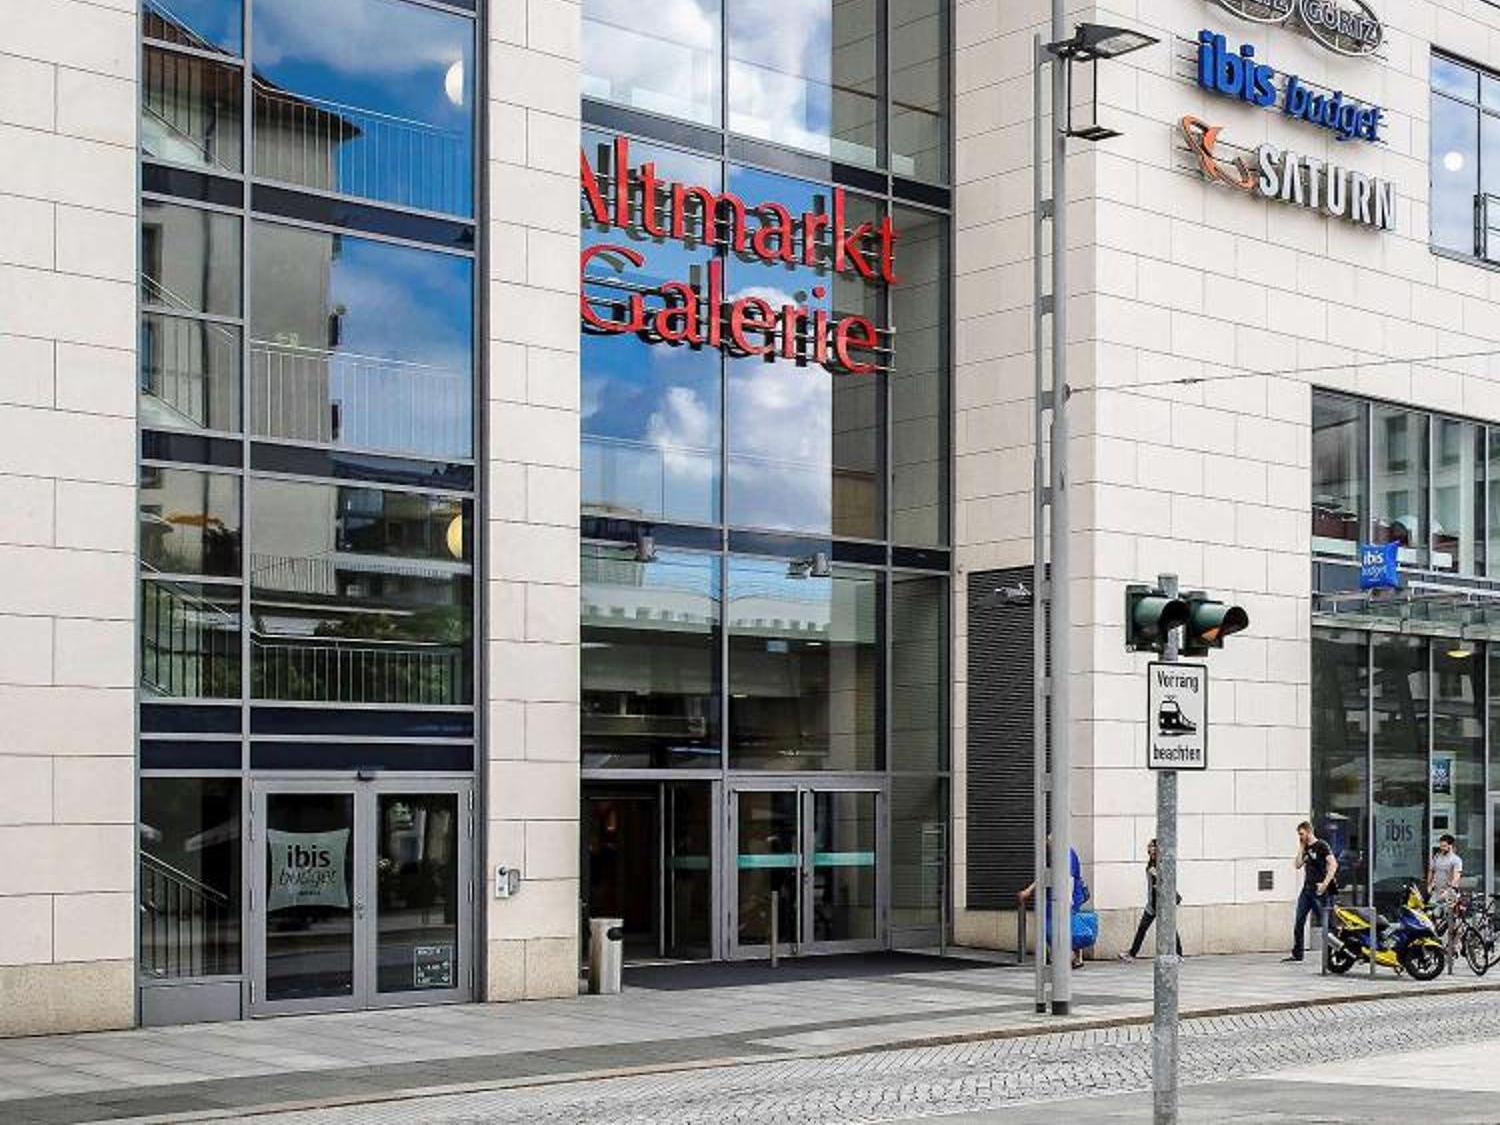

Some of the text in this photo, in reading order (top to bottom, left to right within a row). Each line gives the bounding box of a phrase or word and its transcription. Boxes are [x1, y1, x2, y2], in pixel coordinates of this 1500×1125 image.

[1197, 29, 1385, 143] ibis budget
[1257, 143, 1397, 231] SATURN
[580, 243, 882, 374] Galerie
[1363, 551, 1384, 566] ibis
[1157, 671, 1199, 694] Vorrang
[1153, 743, 1201, 761] beachten
[1385, 819, 1413, 842] ibis
[287, 844, 331, 868] ibis
[279, 868, 337, 887] budget
